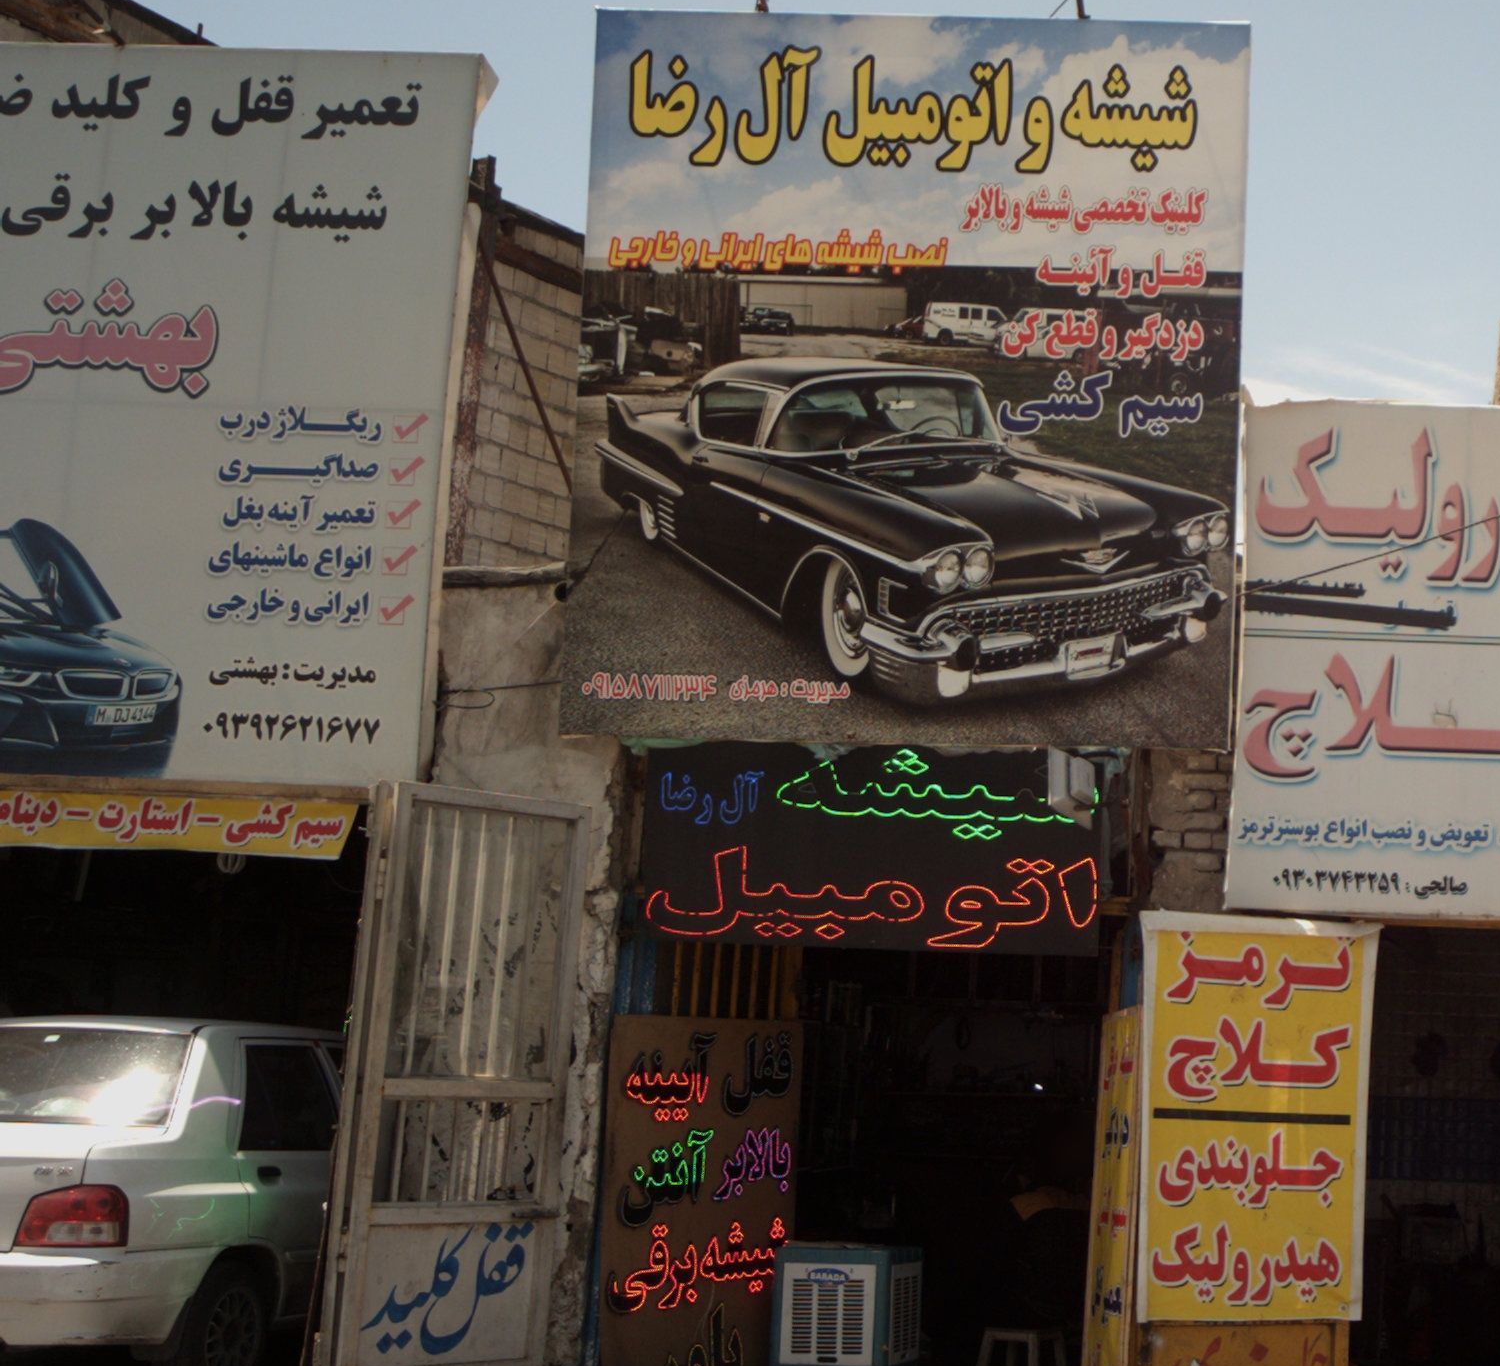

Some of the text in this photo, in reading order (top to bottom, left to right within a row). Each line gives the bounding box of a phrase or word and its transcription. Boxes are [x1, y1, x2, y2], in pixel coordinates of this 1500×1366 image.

[51, 73, 151, 132] کلید
[164, 97, 192, 136] و
[211, 75, 294, 136] قفل
[302, 82, 422, 139] تعمیر
[630, 45, 1196, 172] شیشه و اتومبیل آل رضا
[1, 173, 114, 238] برقی
[273, 184, 388, 242] شیشه
[960, 185, 1206, 234] کلینیک تخصصی شیشه و بالابر
[609, 229, 948, 275] نصب شیشه های ایرانی و خارجی
[1037, 246, 1206, 298] قفل و آئینه
[0, 277, 219, 398] بهشتی
[1002, 308, 1205, 361] دزدگیر و قطع کن
[220, 406, 382, 441] ریگلاژ درب
[998, 370, 1203, 437] سیم کشی
[218, 453, 379, 484] صداگیری
[223, 495, 376, 531] تعمیر آینه بغل
[208, 541, 372, 577] انواع ماشینهای
[207, 588, 369, 624] ایرانی و خارجی
[208, 656, 278, 686] بهشتی
[203, 712, 380, 745] ۰۹۳۹۲۶۲۱۶۷۷
[98, 798, 193, 840] استارت
[226, 803, 293, 843] کشی
[661, 772, 713, 825] رضا
[720, 771, 765, 825] آل
[294, 817, 343, 845] سیم
[1324, 818, 1368, 844] انواع
[1371, 820, 1413, 844] نصب
[1416, 828, 1426, 847] و
[1430, 822, 1489, 847] تعویض
[646, 845, 1098, 948] اتومبیل
[1167, 931, 1351, 1008] ترمز
[723, 1031, 793, 1116] قفل
[1167, 1017, 1350, 1098] کلاچ
[620, 1127, 792, 1228] بالابر آنتن
[1159, 1131, 1342, 1205] جلوبندی
[361, 1220, 535, 1355] قفل کلید
[608, 1223, 699, 1314] برقی
[1152, 1224, 1341, 1303] هیدرولیک
